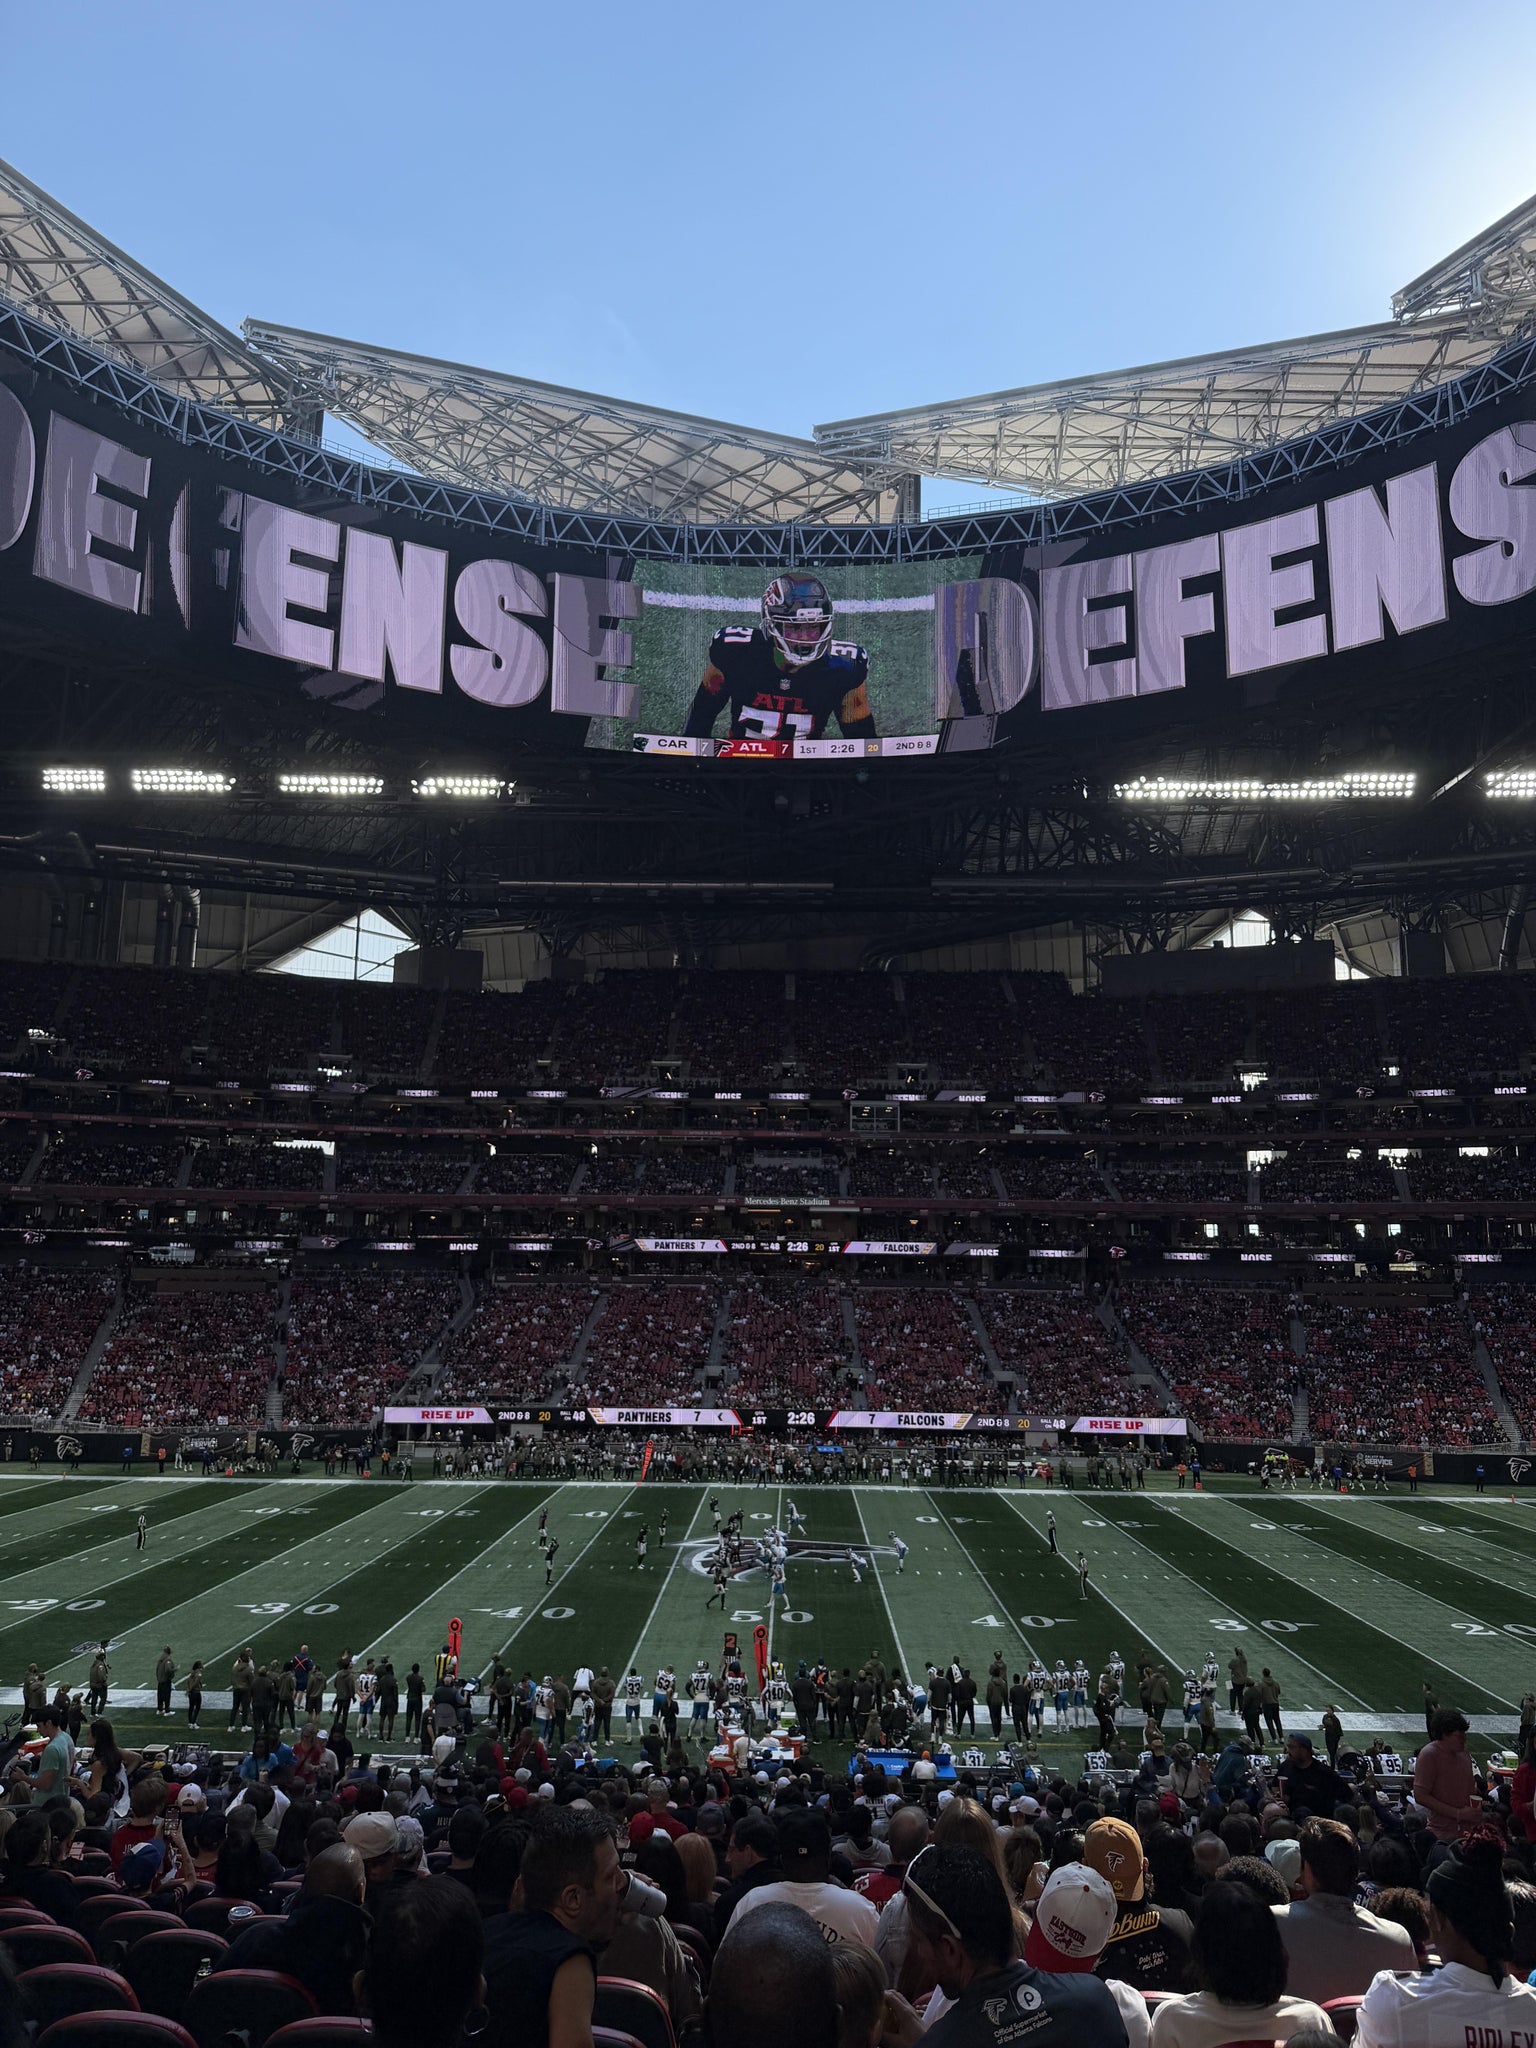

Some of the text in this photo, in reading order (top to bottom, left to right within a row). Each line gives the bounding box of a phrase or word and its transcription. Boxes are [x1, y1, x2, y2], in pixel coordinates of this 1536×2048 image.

[752, 692, 809, 713] ATL
[657, 738, 688, 749] CAR
[701, 742, 709, 752] 7
[739, 742, 767, 752] ATL
[782, 744, 789, 754] 7
[800, 744, 855, 754] 1ST 2:26
[867, 744, 879, 752] 20
[896, 741, 932, 750] 2ND & 8
[471, 1090, 499, 1098] NOISE
[714, 1092, 742, 1100] NOISE
[1494, 1086, 1527, 1095] NOISE
[1211, 1096, 1241, 1104] NOISE
[745, 1197, 798, 1205] Mercedes-Benz
[800, 1197, 830, 1206] Stadium
[450, 1243, 479, 1251] NOISE
[654, 1241, 706, 1250] PANTHERS 7
[770, 1243, 780, 1251] 48
[787, 1242, 825, 1252] 2:26 20
[884, 1244, 919, 1252] FALCONS
[970, 1248, 1000, 1257] NOISE
[1241, 1253, 1273, 1261] NOISE
[421, 1410, 475, 1419] RISE UP
[498, 1411, 517, 1420] 2ND
[525, 1411, 531, 1420] 8
[538, 1411, 551, 1421] 20
[572, 1411, 586, 1422] 48
[618, 1411, 701, 1423] PANTHERS 7
[787, 1411, 816, 1425] 2:26
[869, 1414, 945, 1426] 7 FALCONS
[752, 1416, 768, 1425] 1ST
[977, 1418, 994, 1427] 2ND
[1004, 1418, 1010, 1427] 8
[1017, 1419, 1030, 1429] 20
[1052, 1419, 1067, 1430] 48
[1089, 1420, 1144, 1430] RISE UP
[1364, 1459, 1393, 1467] SERVICE
[8, 1598, 106, 1611] 20
[249, 1602, 340, 1615] 30
[489, 1606, 576, 1619] 40
[729, 1610, 815, 1623] 50
[971, 1614, 1056, 1628] 40
[1208, 1619, 1299, 1632] 30
[1450, 1622, 1536, 1637] 20
[725, 1634, 736, 1648] 2
[359, 1679, 369, 1693] 14
[657, 1676, 670, 1689] 63
[694, 1678, 706, 1691] 77
[1059, 1679, 1069, 1690] 18
[628, 1682, 641, 1696] 33
[728, 1682, 741, 1696] 29
[772, 1687, 784, 1700] 40
[1189, 1687, 1201, 1699] 55
[969, 1756, 980, 1766] 31
[1090, 1756, 1105, 1769] 53
[1386, 1759, 1401, 1772] 95
[993, 2010, 1048, 2038] Official Supermarket
[1014, 2026, 1034, 2038] Atlanta
[1032, 2016, 1053, 2030] Falcons
